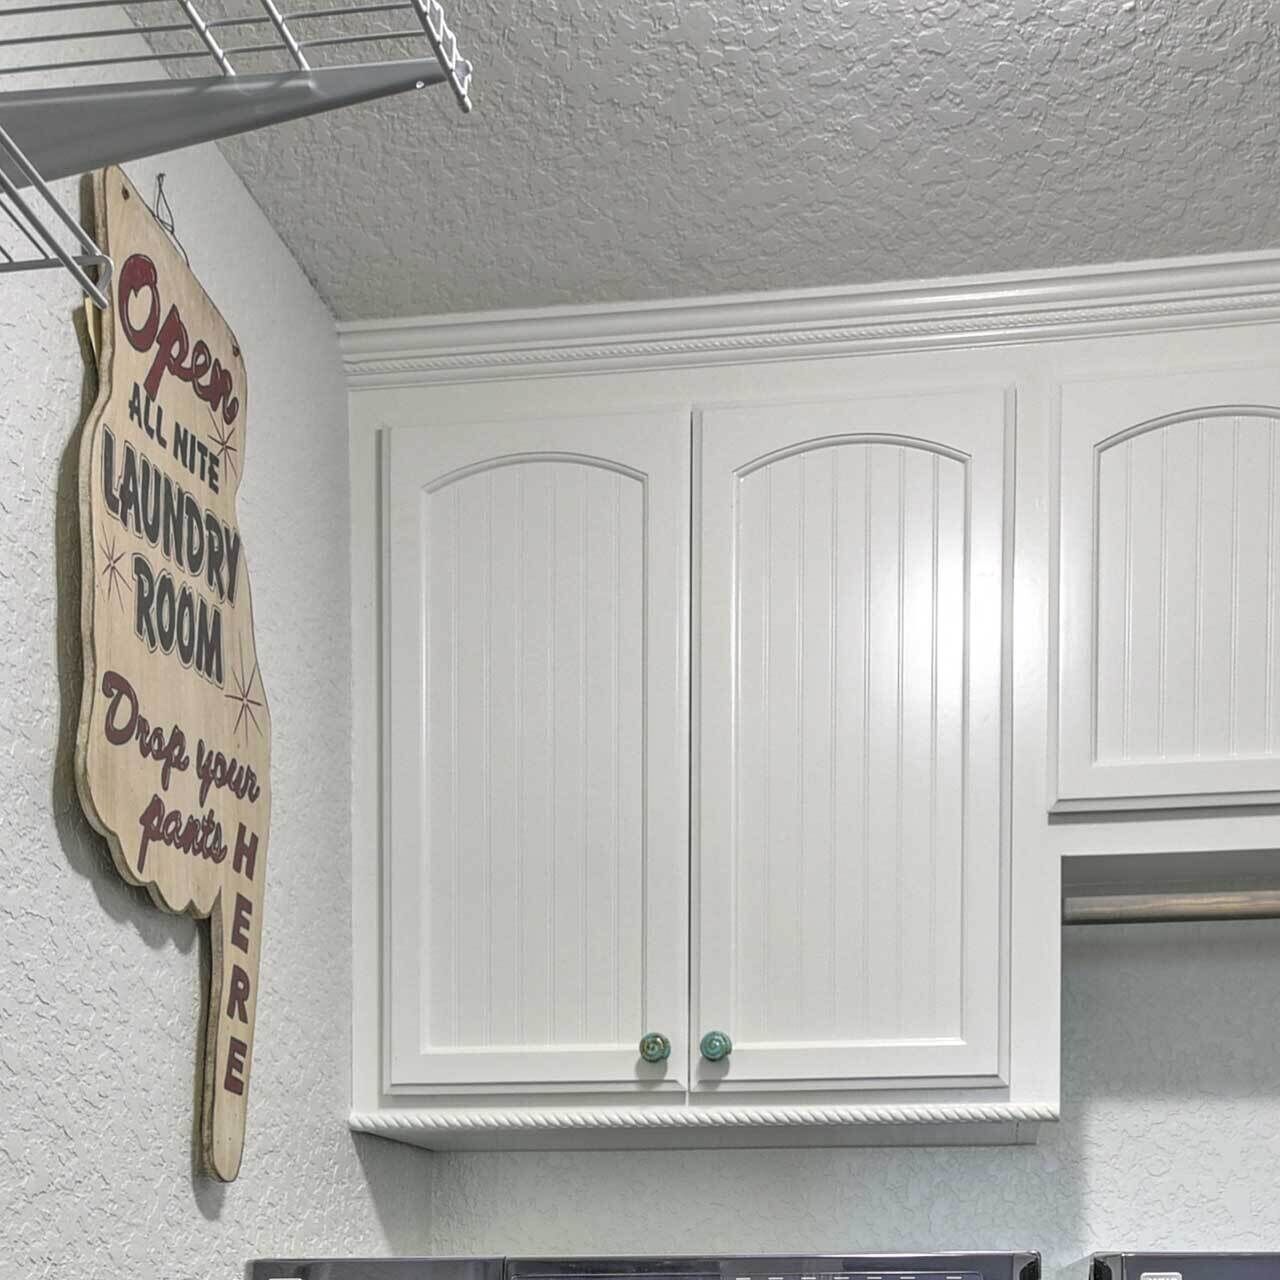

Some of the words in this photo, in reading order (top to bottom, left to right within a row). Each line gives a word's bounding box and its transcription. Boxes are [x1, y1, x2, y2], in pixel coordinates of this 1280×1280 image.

[118, 253, 239, 425] Open
[129, 381, 167, 449] ALL
[173, 421, 220, 494] NITE
[101, 423, 242, 608] LAUNDRY
[131, 552, 224, 689] ROOM
[101, 670, 189, 791] Drop
[196, 739, 261, 808] your
[138, 794, 228, 874] pants
[224, 822, 259, 1096] HERE
